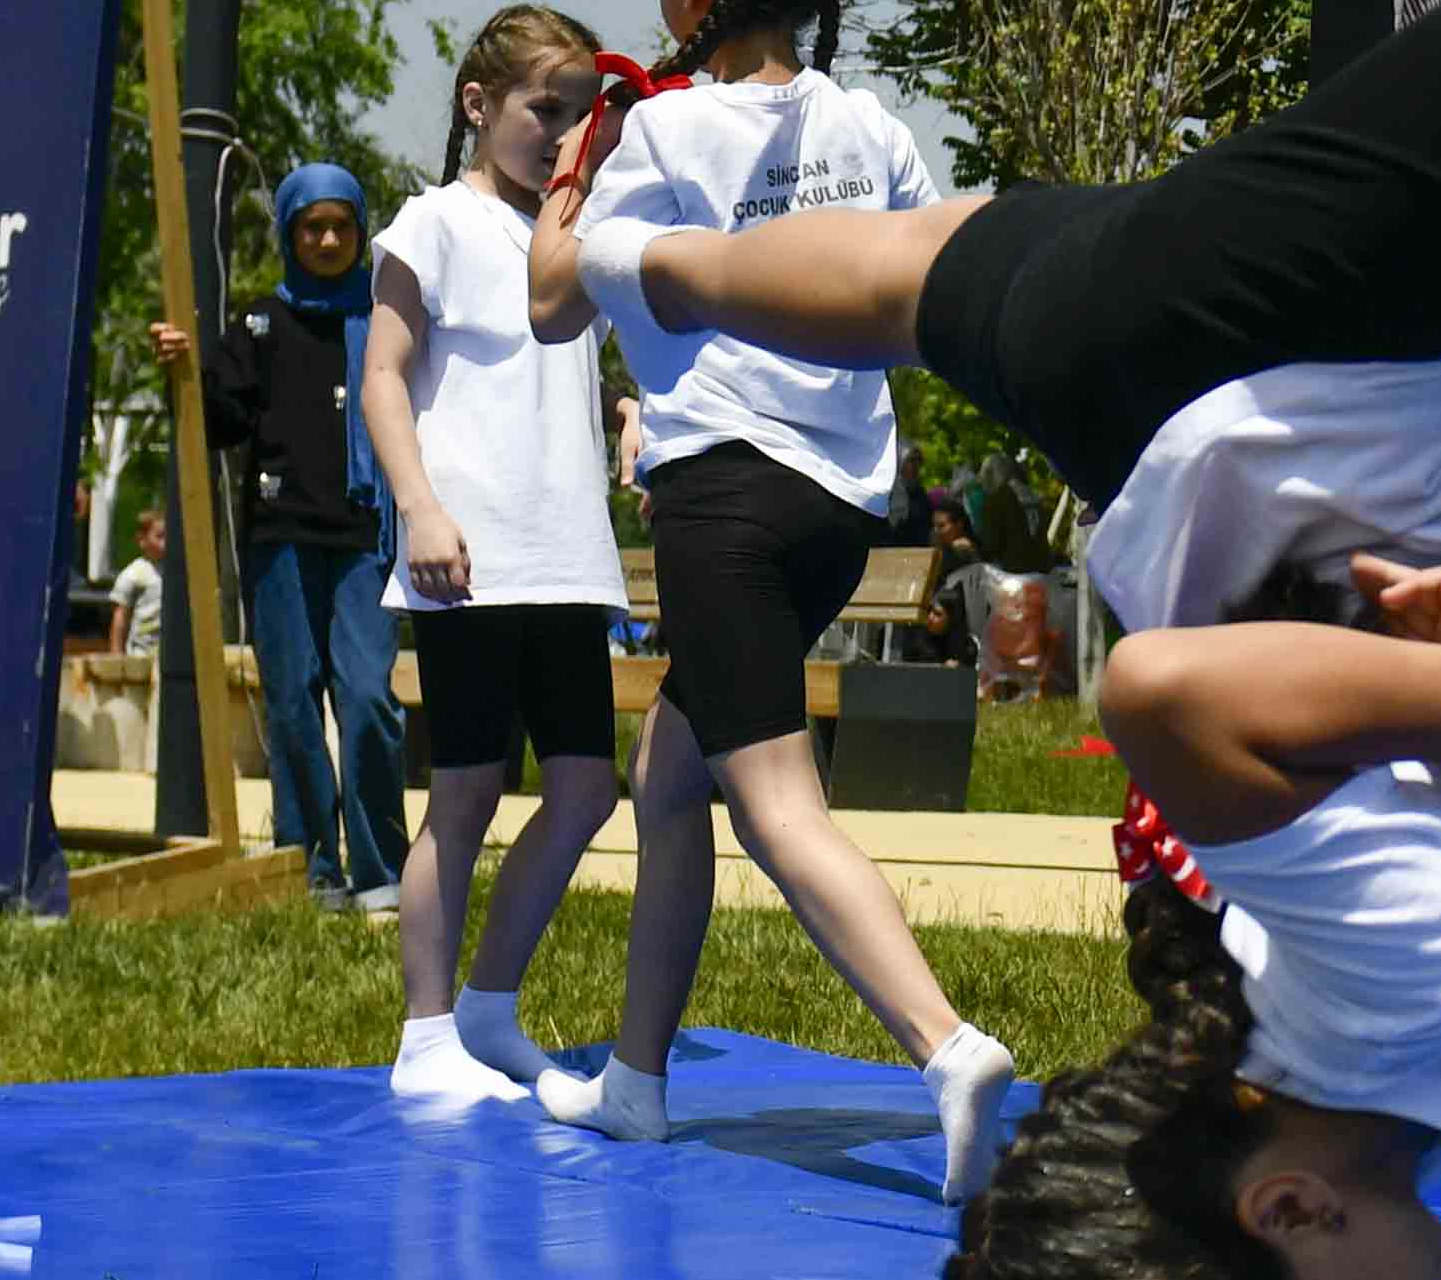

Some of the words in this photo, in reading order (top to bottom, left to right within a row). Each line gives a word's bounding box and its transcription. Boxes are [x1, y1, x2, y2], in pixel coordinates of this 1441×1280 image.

[767, 159, 830, 187] SİNCAN
[733, 194, 792, 225] ÇOCUK
[797, 175, 874, 208] KULÜBÜ
